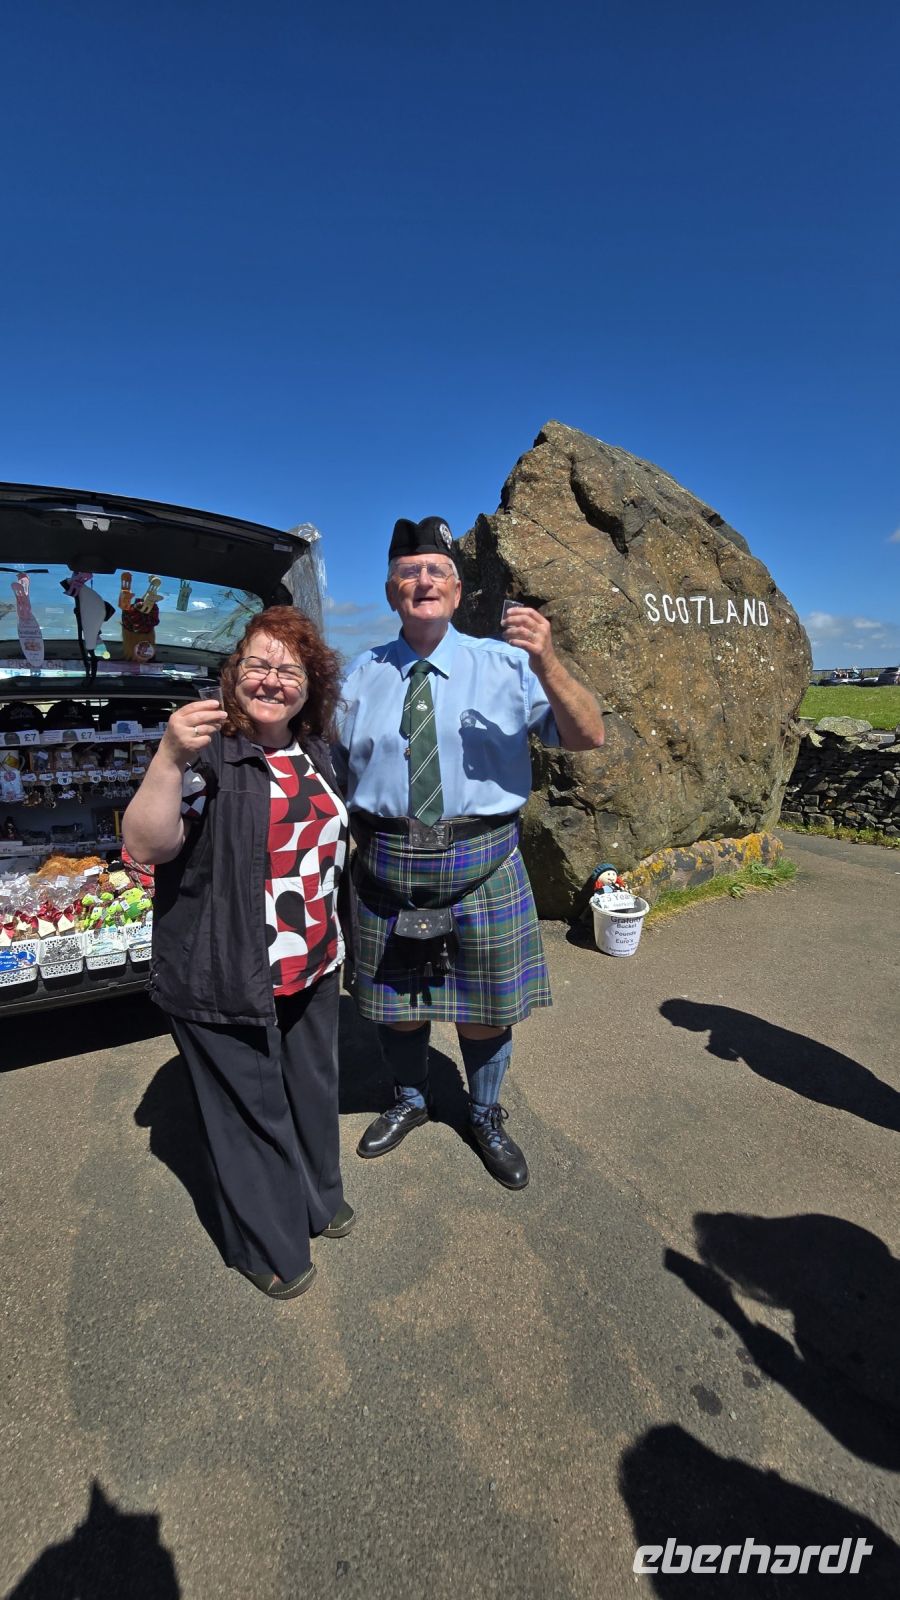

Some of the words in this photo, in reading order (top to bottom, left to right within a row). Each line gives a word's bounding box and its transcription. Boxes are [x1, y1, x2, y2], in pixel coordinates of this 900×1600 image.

[644, 593, 769, 627] SCOTLAND
[24, 733, 37, 742] £7
[80, 731, 93, 740] £7
